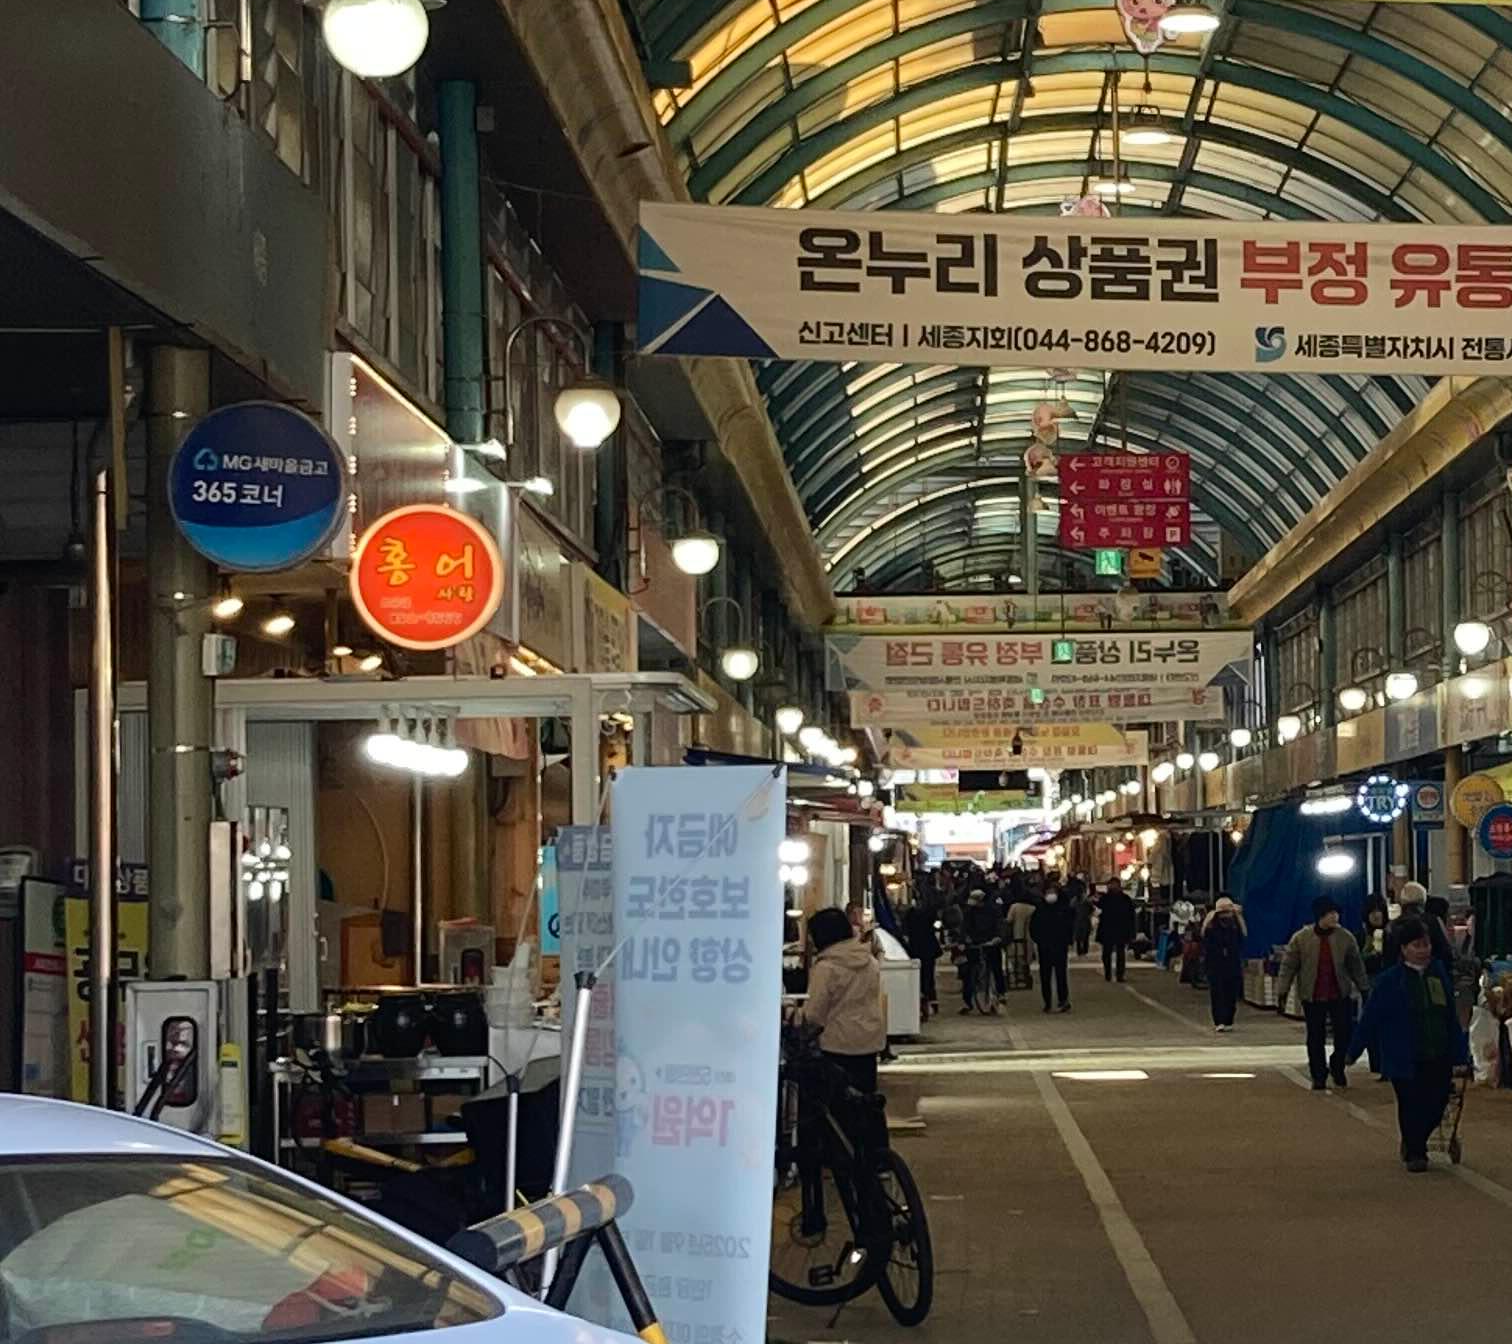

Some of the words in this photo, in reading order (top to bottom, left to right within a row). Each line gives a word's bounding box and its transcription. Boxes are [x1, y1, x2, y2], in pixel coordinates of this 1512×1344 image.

[797, 227, 998, 298] 온누리
[1022, 236, 1220, 303] 상품권
[1240, 239, 1369, 308] 부정
[799, 321, 893, 349] 신고센터
[918, 324, 1217, 358] 세종지회(044-868-4209)
[1294, 332, 1455, 363] 세종특별자치시
[222, 454, 329, 476] MG새마을금고
